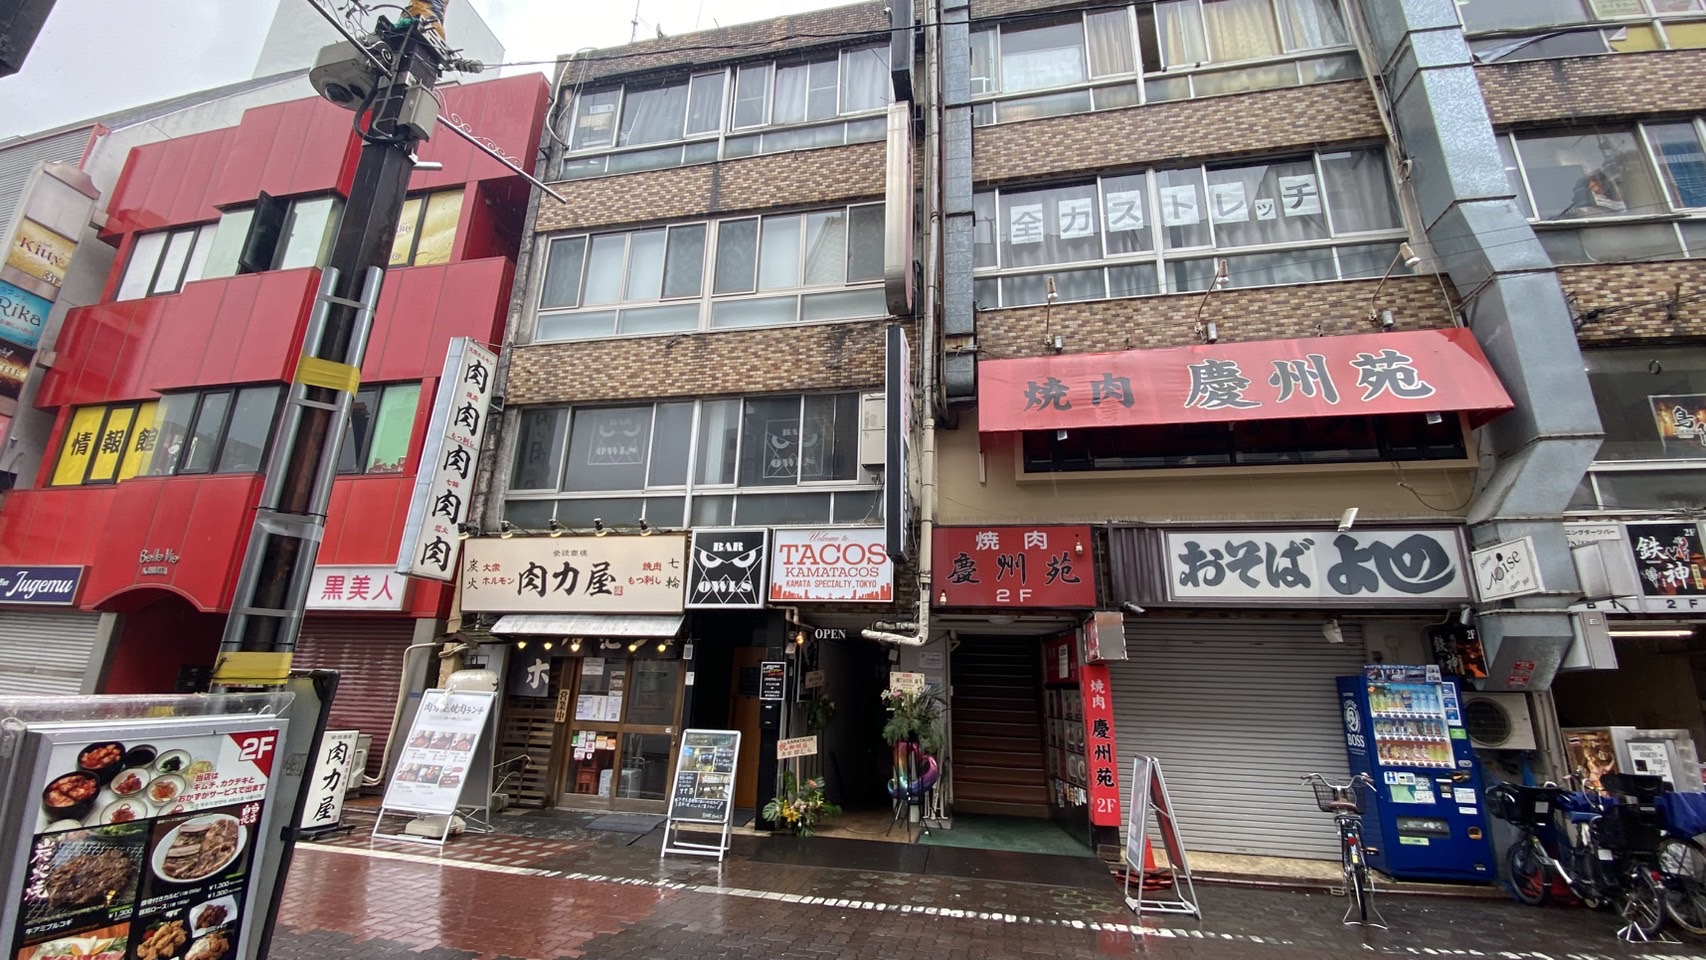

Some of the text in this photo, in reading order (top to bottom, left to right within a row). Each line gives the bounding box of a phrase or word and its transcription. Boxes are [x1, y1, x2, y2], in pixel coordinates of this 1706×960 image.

[1012, 182, 1317, 240] 全力ストレッチ
[1022, 348, 1437, 413] 焼肉 慶州苑
[70, 428, 159, 456] 情報館
[808, 531, 839, 543] Welcome
[976, 530, 1048, 550] 焼肉
[713, 542, 744, 552] BAR
[779, 543, 887, 566] TACOS
[482, 563, 501, 572] 大衆
[642, 562, 662, 572] 焼肉
[785, 567, 879, 578] KAMATACOS
[946, 552, 1081, 585] 慶州苑
[1178, 538, 1315, 589] おそば
[6, 571, 73, 599] Jugemu
[321, 574, 393, 600] 黒美人
[482, 577, 515, 586] ホルモン
[517, 561, 616, 598] 肉力屋
[627, 574, 662, 586] もつ刺し
[698, 580, 752, 593] OWLS
[786, 580, 811, 588] KAMATA
[996, 589, 1032, 602] 2F
[815, 629, 846, 639] OPEN
[1090, 679, 1107, 709] 焼肉
[556, 690, 569, 722] 営業中
[239, 736, 275, 761] 2F
[1347, 733, 1365, 748] BOSS
[1091, 718, 1116, 788] 慶州苑
[195, 773, 219, 782] 当店は
[313, 741, 348, 821] 肉力屋
[178, 784, 266, 802] おかずがサービスで出ます
[1097, 798, 1116, 813] 2F
